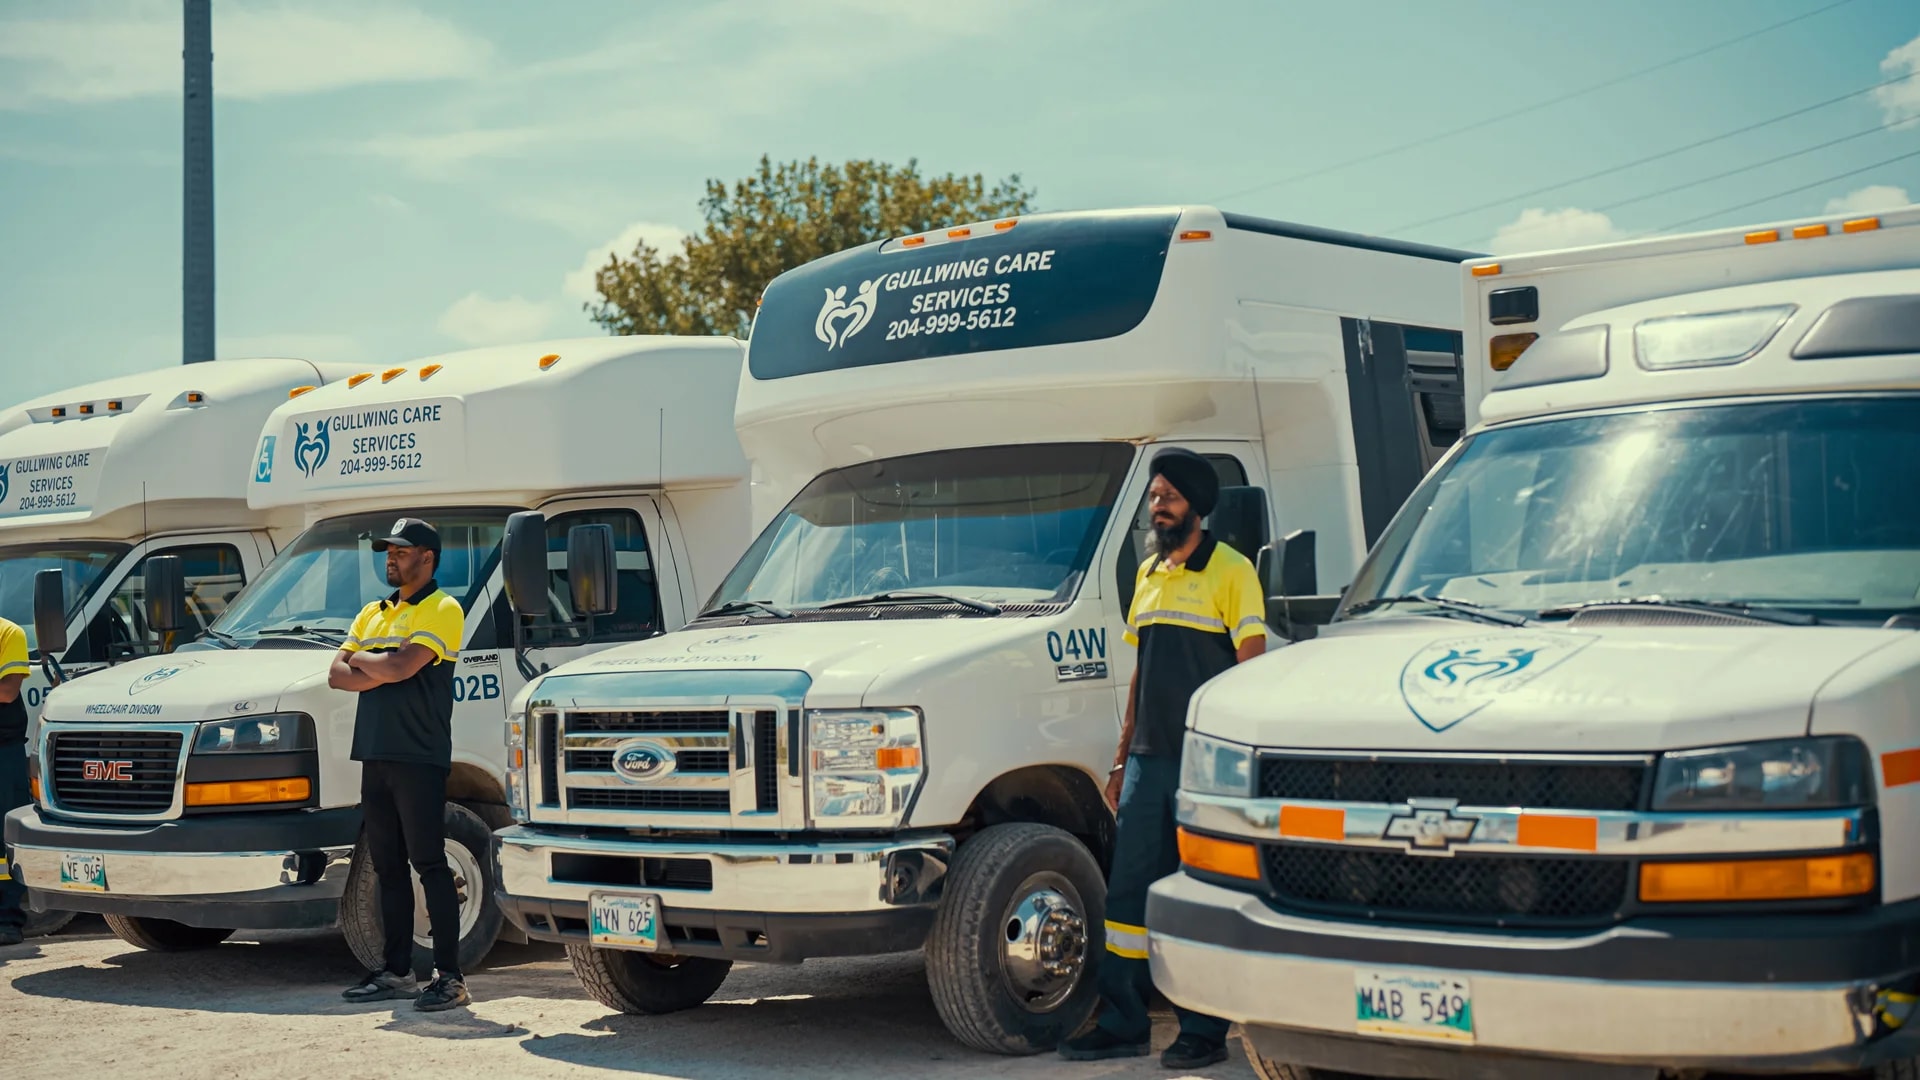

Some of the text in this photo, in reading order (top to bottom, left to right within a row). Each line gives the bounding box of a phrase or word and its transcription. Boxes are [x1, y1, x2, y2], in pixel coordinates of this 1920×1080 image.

[885, 249, 1056, 292] GULLWING CARE
[910, 283, 1011, 314] SERVICES
[885, 306, 1017, 341] 204-999-5612
[332, 405, 442, 432] GULLWING CARE
[352, 432, 416, 454] SERVICES
[15, 453, 90, 474] GULLWING CARE
[340, 452, 422, 475] 204-999-5612
[29, 476, 73, 493] SERVICES
[19, 492, 76, 510] 204-999-5612
[1046, 627, 1106, 662] 04W
[463, 653, 499, 664] OVERLAND
[1057, 661, 1107, 677] E-450
[452, 673, 500, 702] 02B
[85, 703, 162, 715] WHEELCHAIR DIVISION
[82, 760, 133, 781] GMC
[624, 752, 651, 770] Ford
[84, 863, 102, 882] 965
[594, 907, 652, 933] HYN 625
[1361, 986, 1464, 1024] MAB 549
